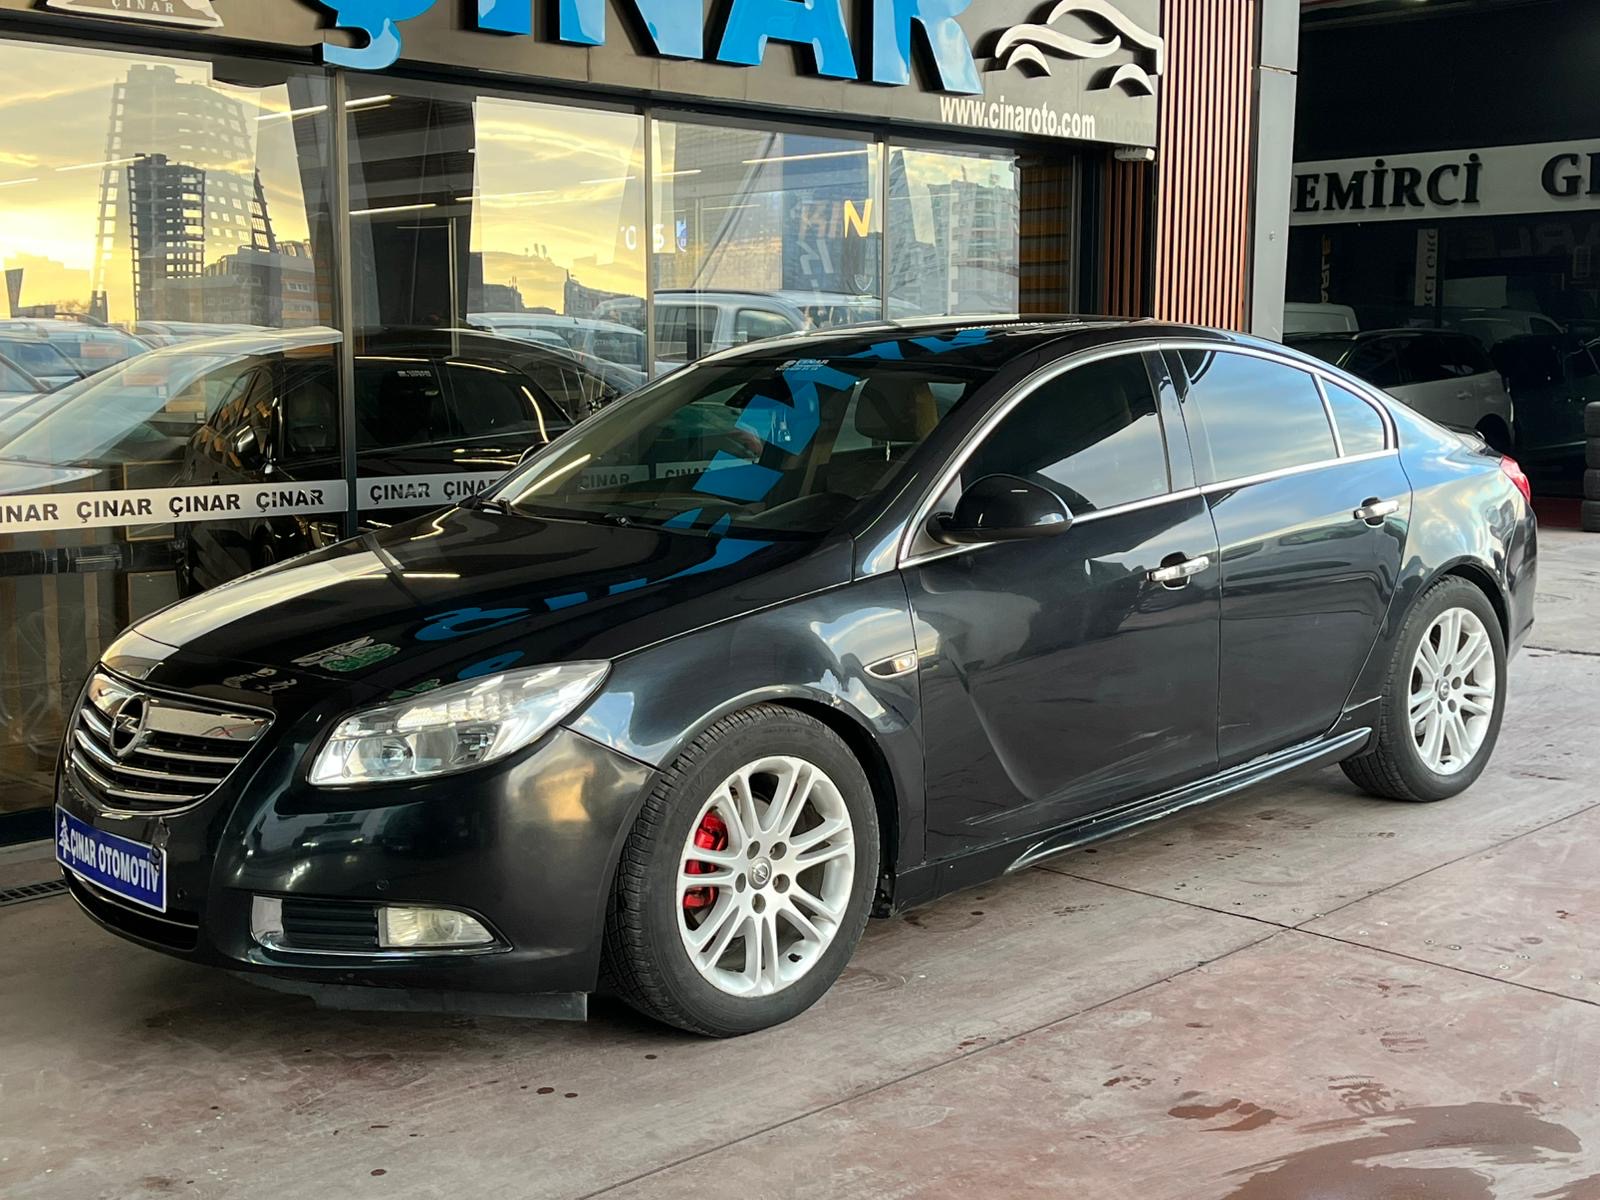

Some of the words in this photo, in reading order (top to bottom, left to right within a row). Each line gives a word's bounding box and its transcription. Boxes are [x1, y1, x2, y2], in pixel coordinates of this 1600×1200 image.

[939, 95, 1096, 139] www.cinaroto.com
[76, 498, 152, 523] ÇINAR
[169, 493, 241, 518] ÇINAR
[256, 489, 324, 513] ÇINAR
[370, 482, 430, 505] ÇINAR
[443, 479, 497, 500] ÇINA
[70, 828, 97, 869] ÇINAR
[98, 843, 160, 893] OTOMOTİV
